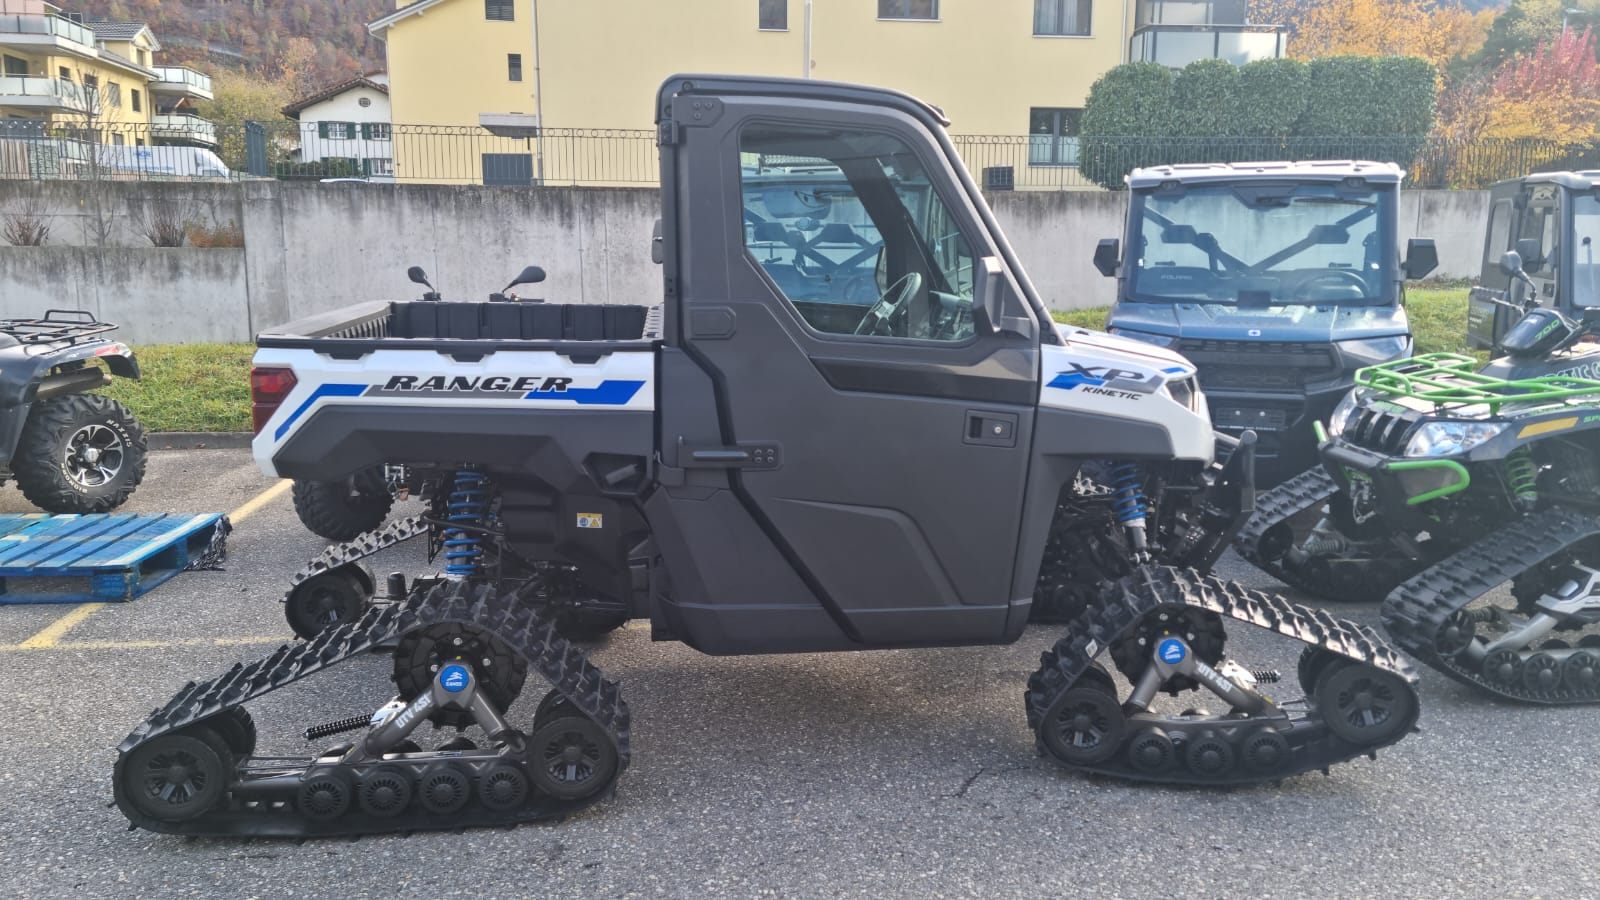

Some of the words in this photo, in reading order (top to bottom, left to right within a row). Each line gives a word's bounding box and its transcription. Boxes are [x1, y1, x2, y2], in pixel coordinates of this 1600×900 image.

[1056, 361, 1145, 381] XP
[383, 375, 574, 392] RANGER
[1082, 386, 1144, 401] KINETIC
[105, 419, 133, 448] MAXXIS
[1198, 661, 1217, 681] UTV
[395, 708, 415, 729] UTV
